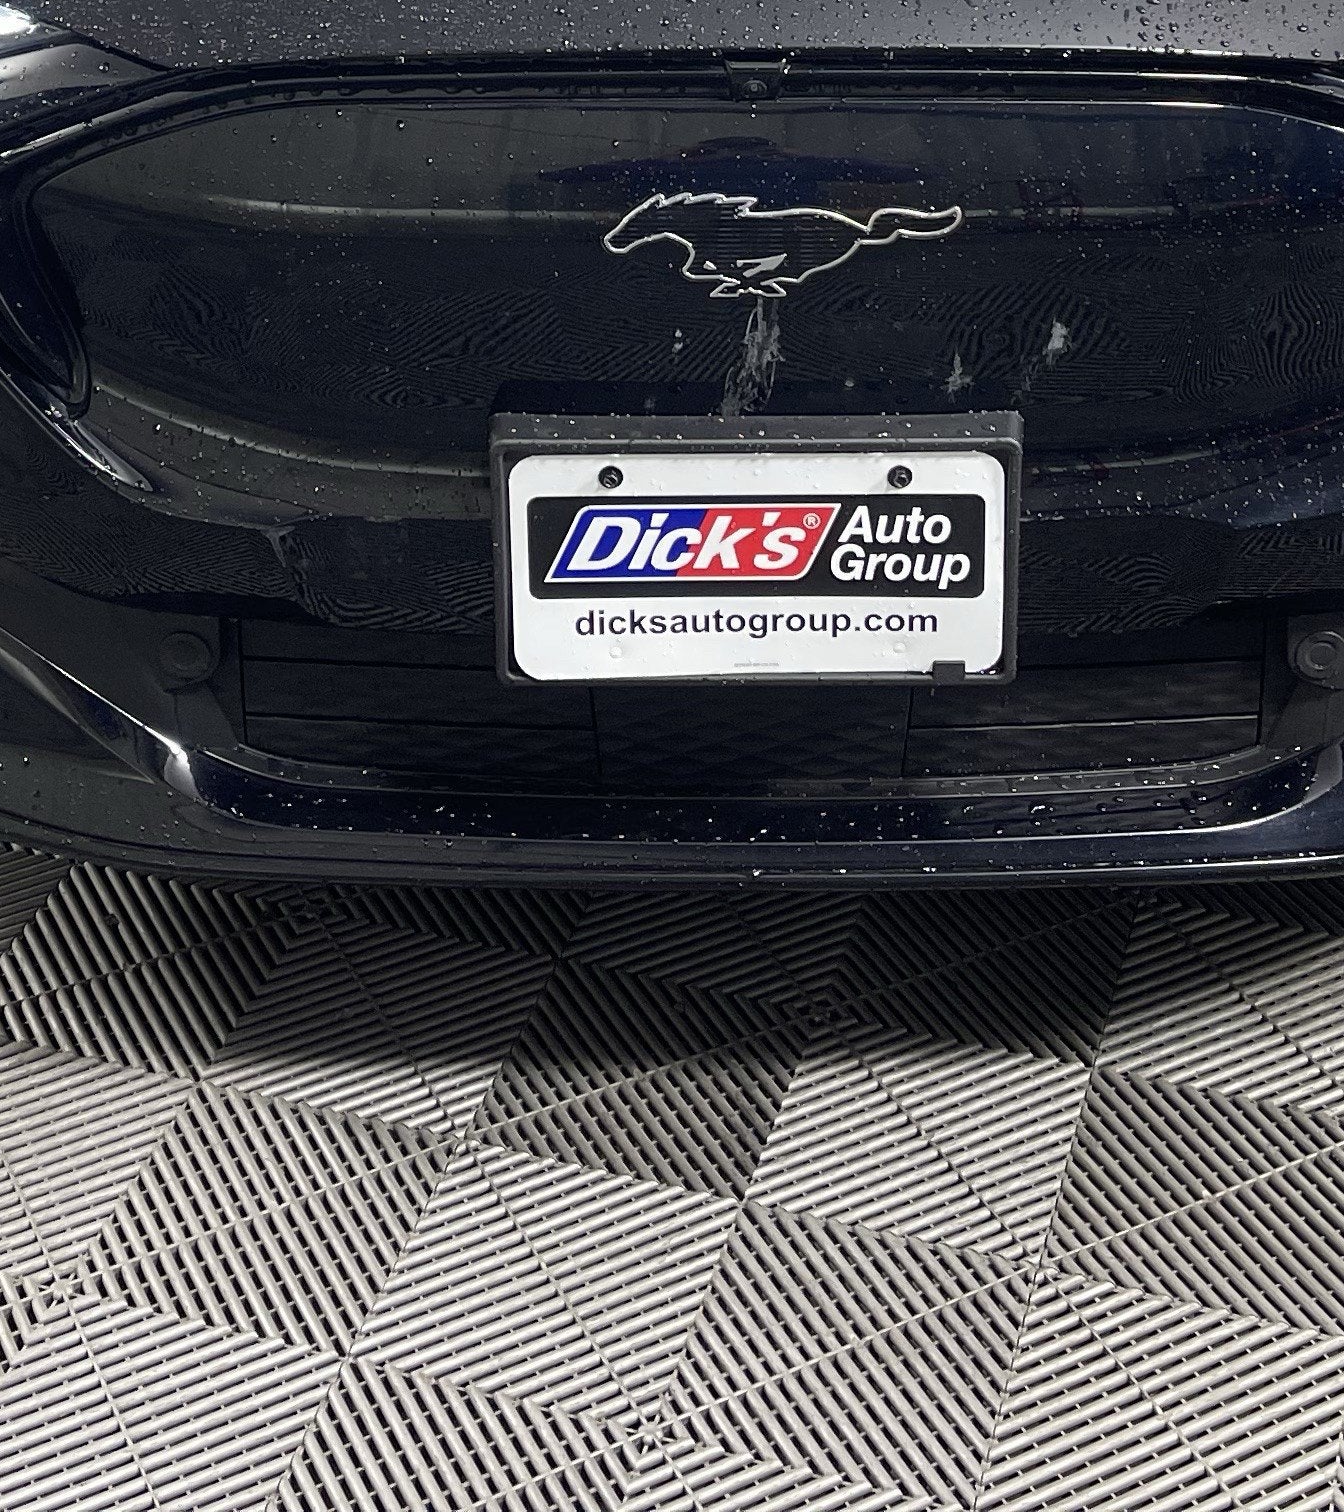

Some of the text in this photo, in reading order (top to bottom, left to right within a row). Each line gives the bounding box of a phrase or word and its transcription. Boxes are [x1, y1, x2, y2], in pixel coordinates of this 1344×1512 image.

[566, 511, 808, 571] Dick's
[837, 505, 952, 544] Auto
[830, 543, 971, 590] Group
[575, 609, 938, 638] dicksautogroup.com
